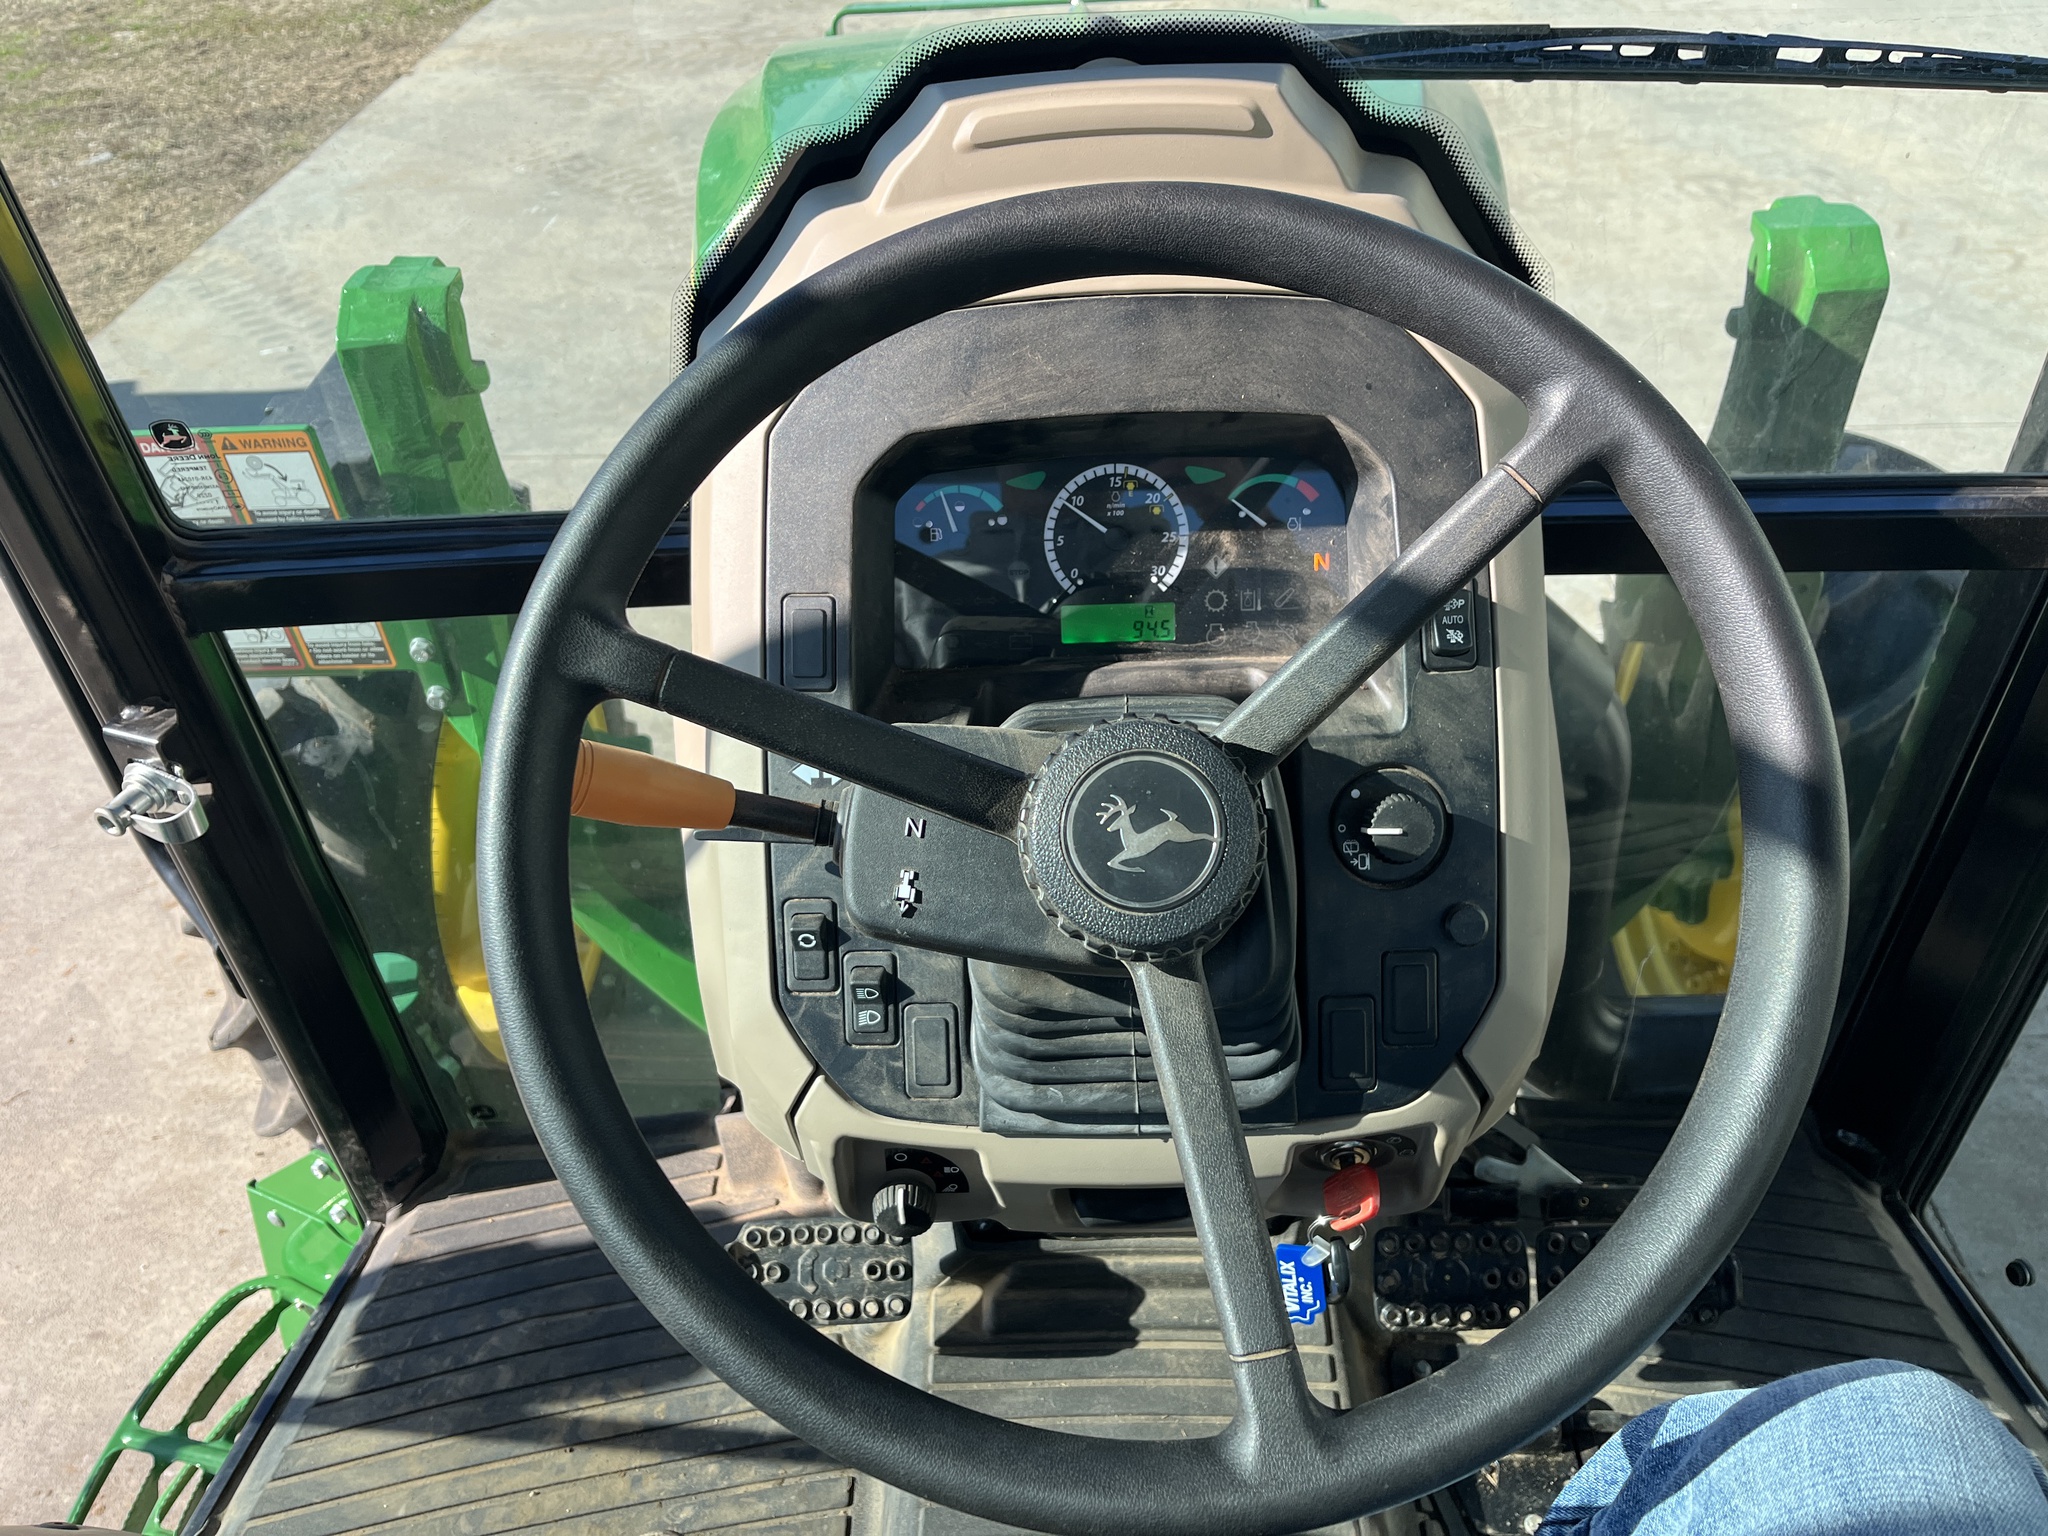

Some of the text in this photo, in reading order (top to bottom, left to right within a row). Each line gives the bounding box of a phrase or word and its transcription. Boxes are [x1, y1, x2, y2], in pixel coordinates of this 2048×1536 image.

[239, 436, 307, 449] WARNING
[1109, 476, 1122, 488] 15
[1071, 495, 1085, 507] 10
[1145, 493, 1161, 504] 20
[1056, 535, 1065, 546] 5
[1161, 531, 1177, 543] 25
[1313, 552, 1330, 571] N
[1070, 568, 1079, 579] 0
[1150, 565, 1166, 577] 30
[1442, 615, 1464, 625] AUTO
[1133, 620, 1171, 639] 94.5
[904, 816, 925, 839] N
[1279, 1260, 1301, 1313] VITALIX
